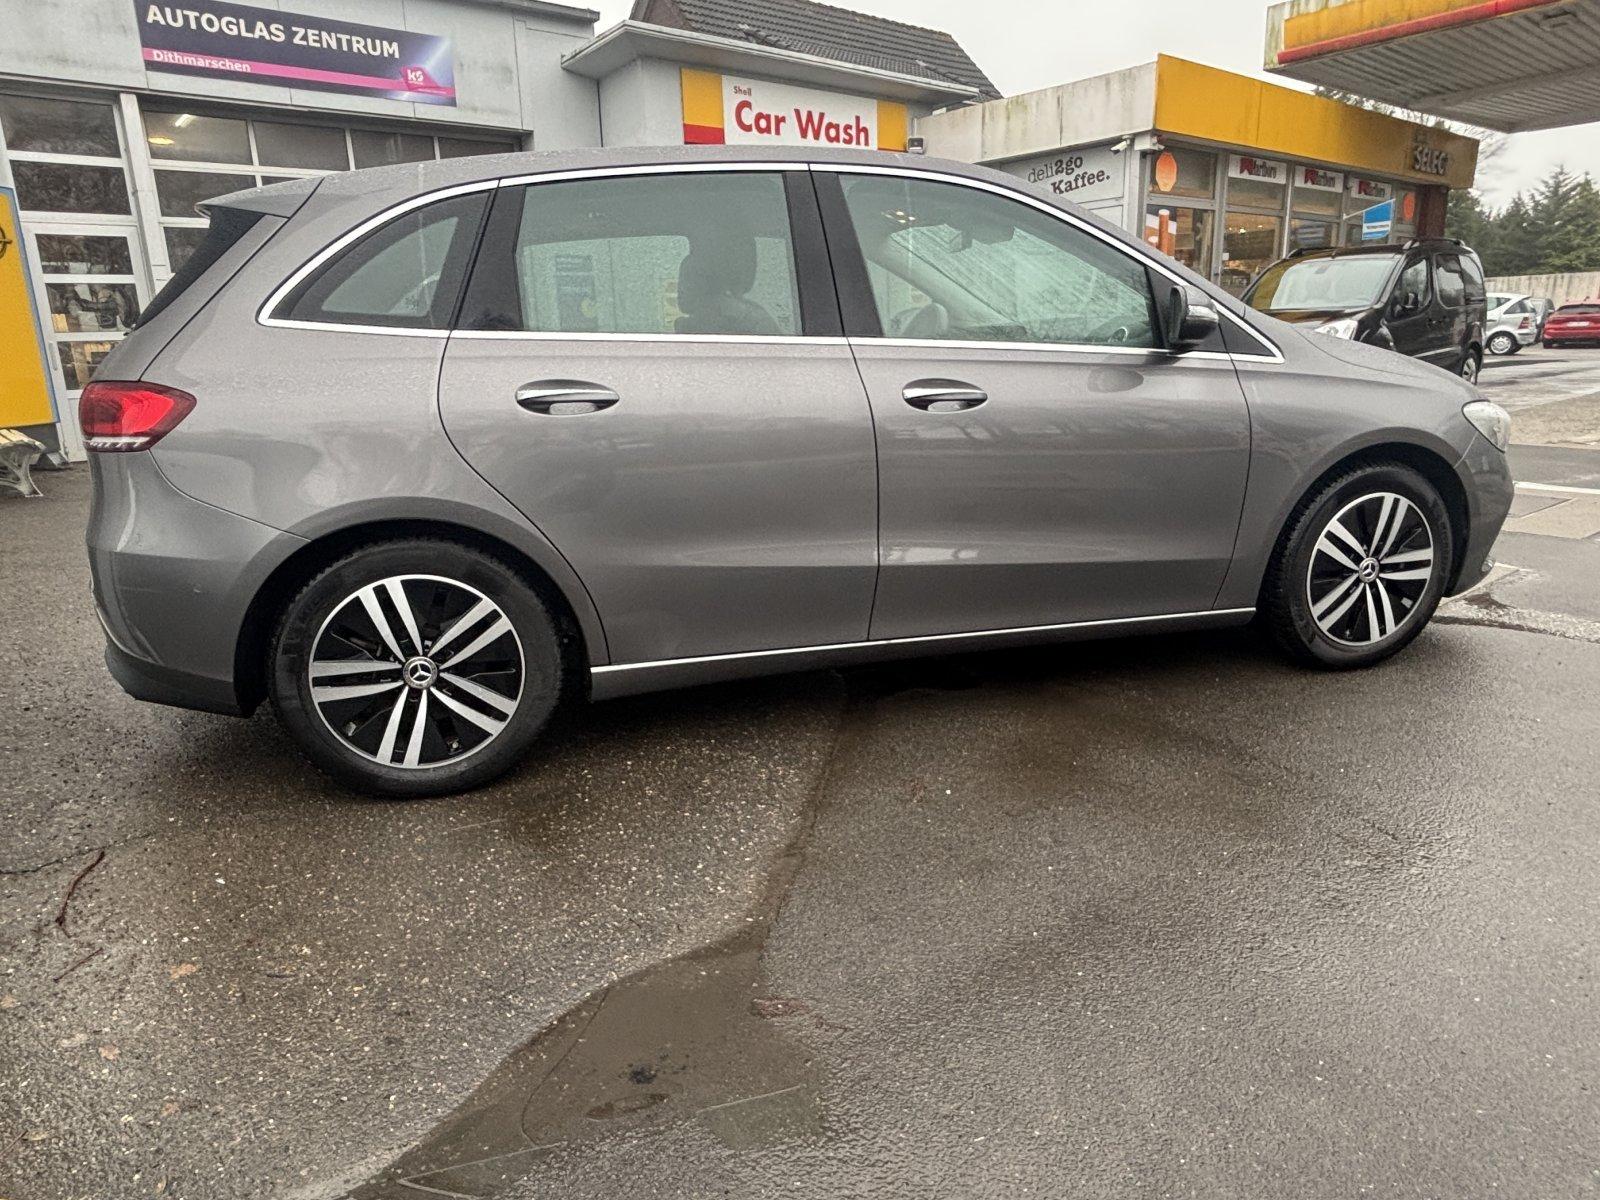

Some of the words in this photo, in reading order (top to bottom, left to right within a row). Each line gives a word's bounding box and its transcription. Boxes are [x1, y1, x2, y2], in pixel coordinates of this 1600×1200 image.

[146, 4, 286, 43] AUTOGLAS
[291, 26, 400, 59] ZENTRUM
[152, 49, 252, 73] Dithmarschen
[733, 85, 752, 97] Shell
[734, 99, 787, 136] Car
[793, 108, 870, 147] Wash
[1027, 156, 1084, 184] deli2go
[1051, 169, 1111, 195] Kaffee.
